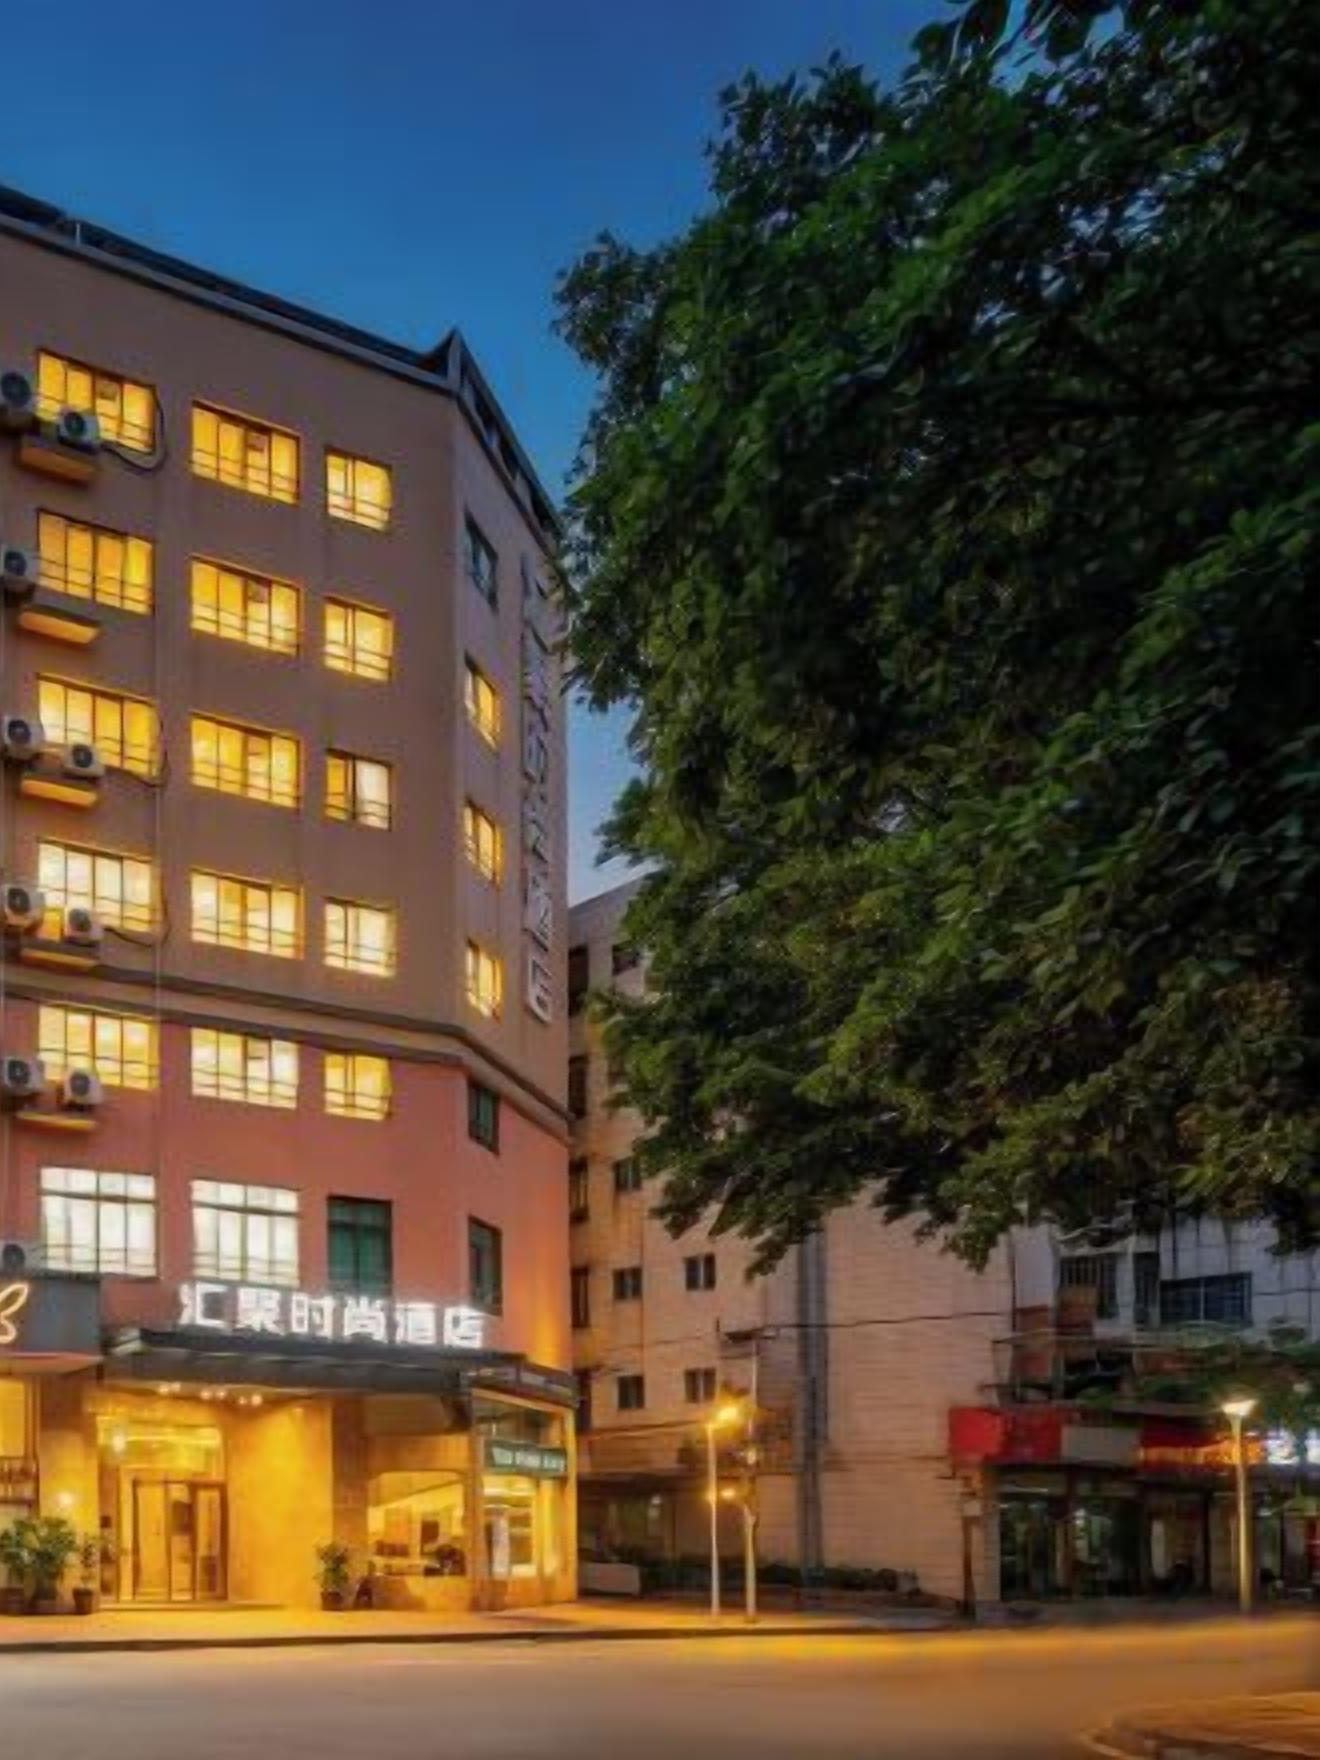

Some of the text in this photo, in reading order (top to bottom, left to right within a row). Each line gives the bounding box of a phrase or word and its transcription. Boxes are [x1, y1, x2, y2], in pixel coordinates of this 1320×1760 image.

[179, 1282, 484, 1349] 汇聚时尚酒店
